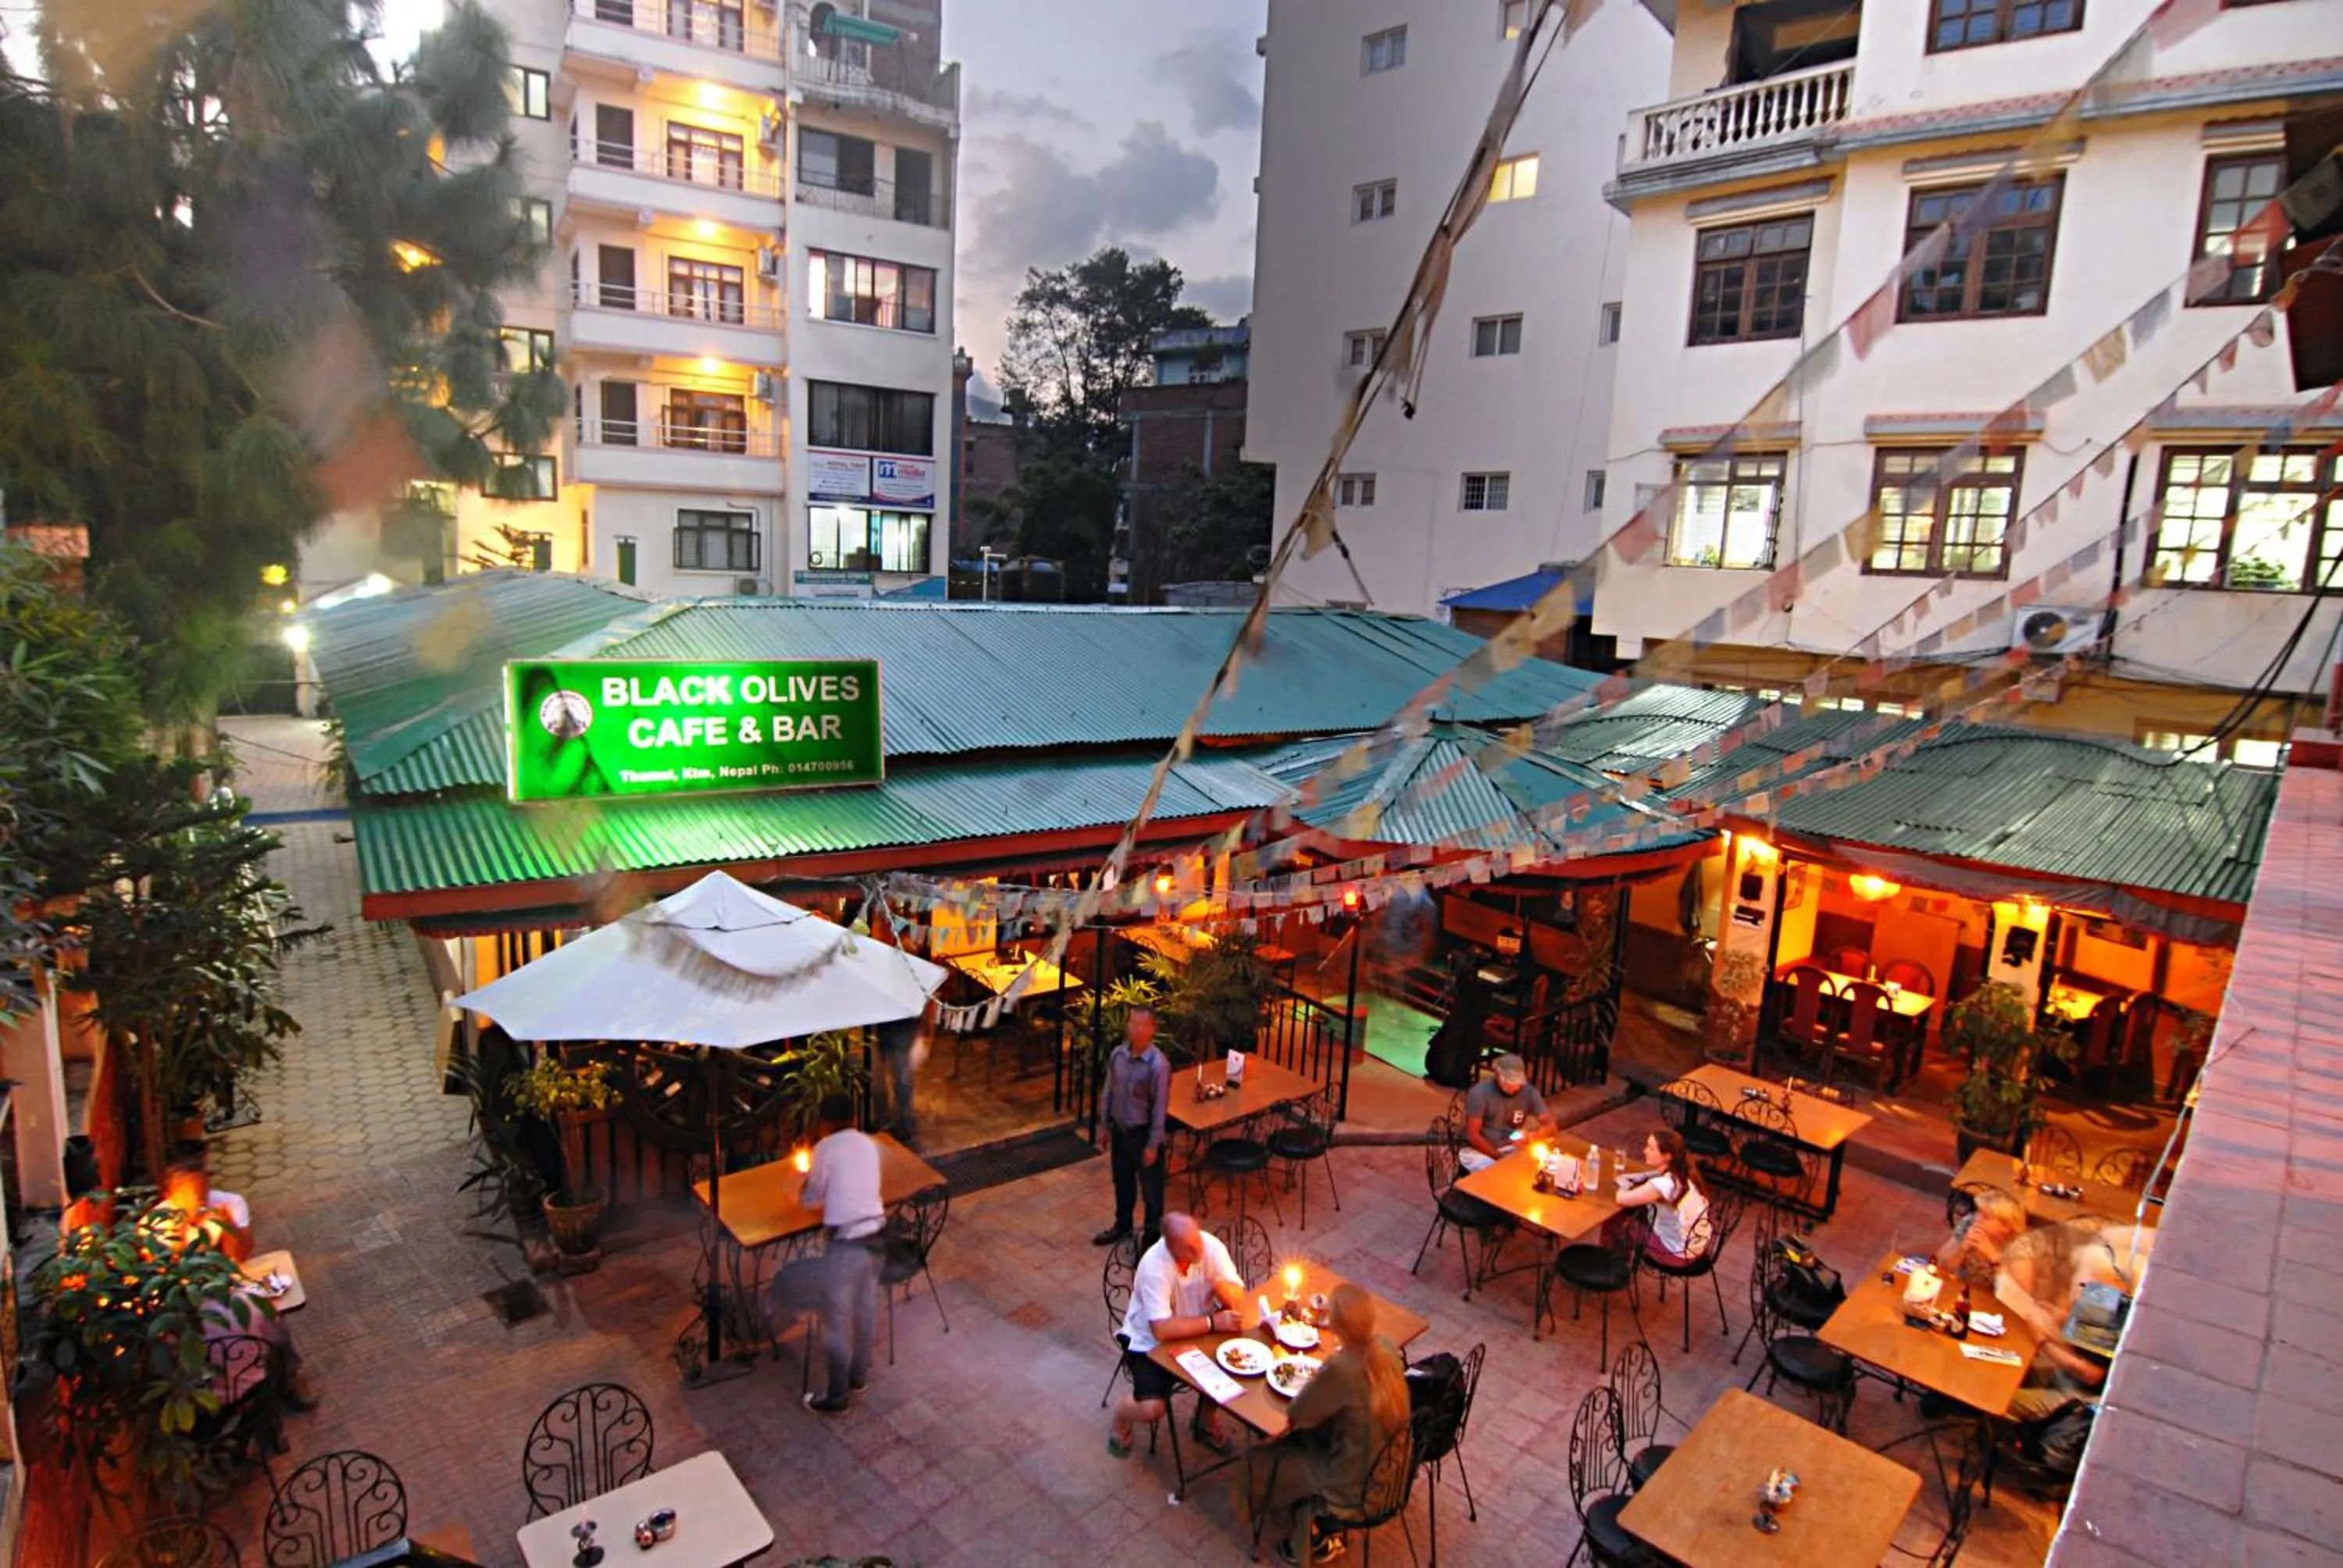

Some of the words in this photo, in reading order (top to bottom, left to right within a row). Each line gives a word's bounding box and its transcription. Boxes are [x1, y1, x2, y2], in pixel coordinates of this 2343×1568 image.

[602, 675, 733, 707] BLACK
[740, 675, 860, 703] OLIVES
[628, 717, 728, 749] CAFE
[738, 716, 762, 743] &
[772, 715, 843, 742] BAR
[719, 765, 757, 778] Nepal
